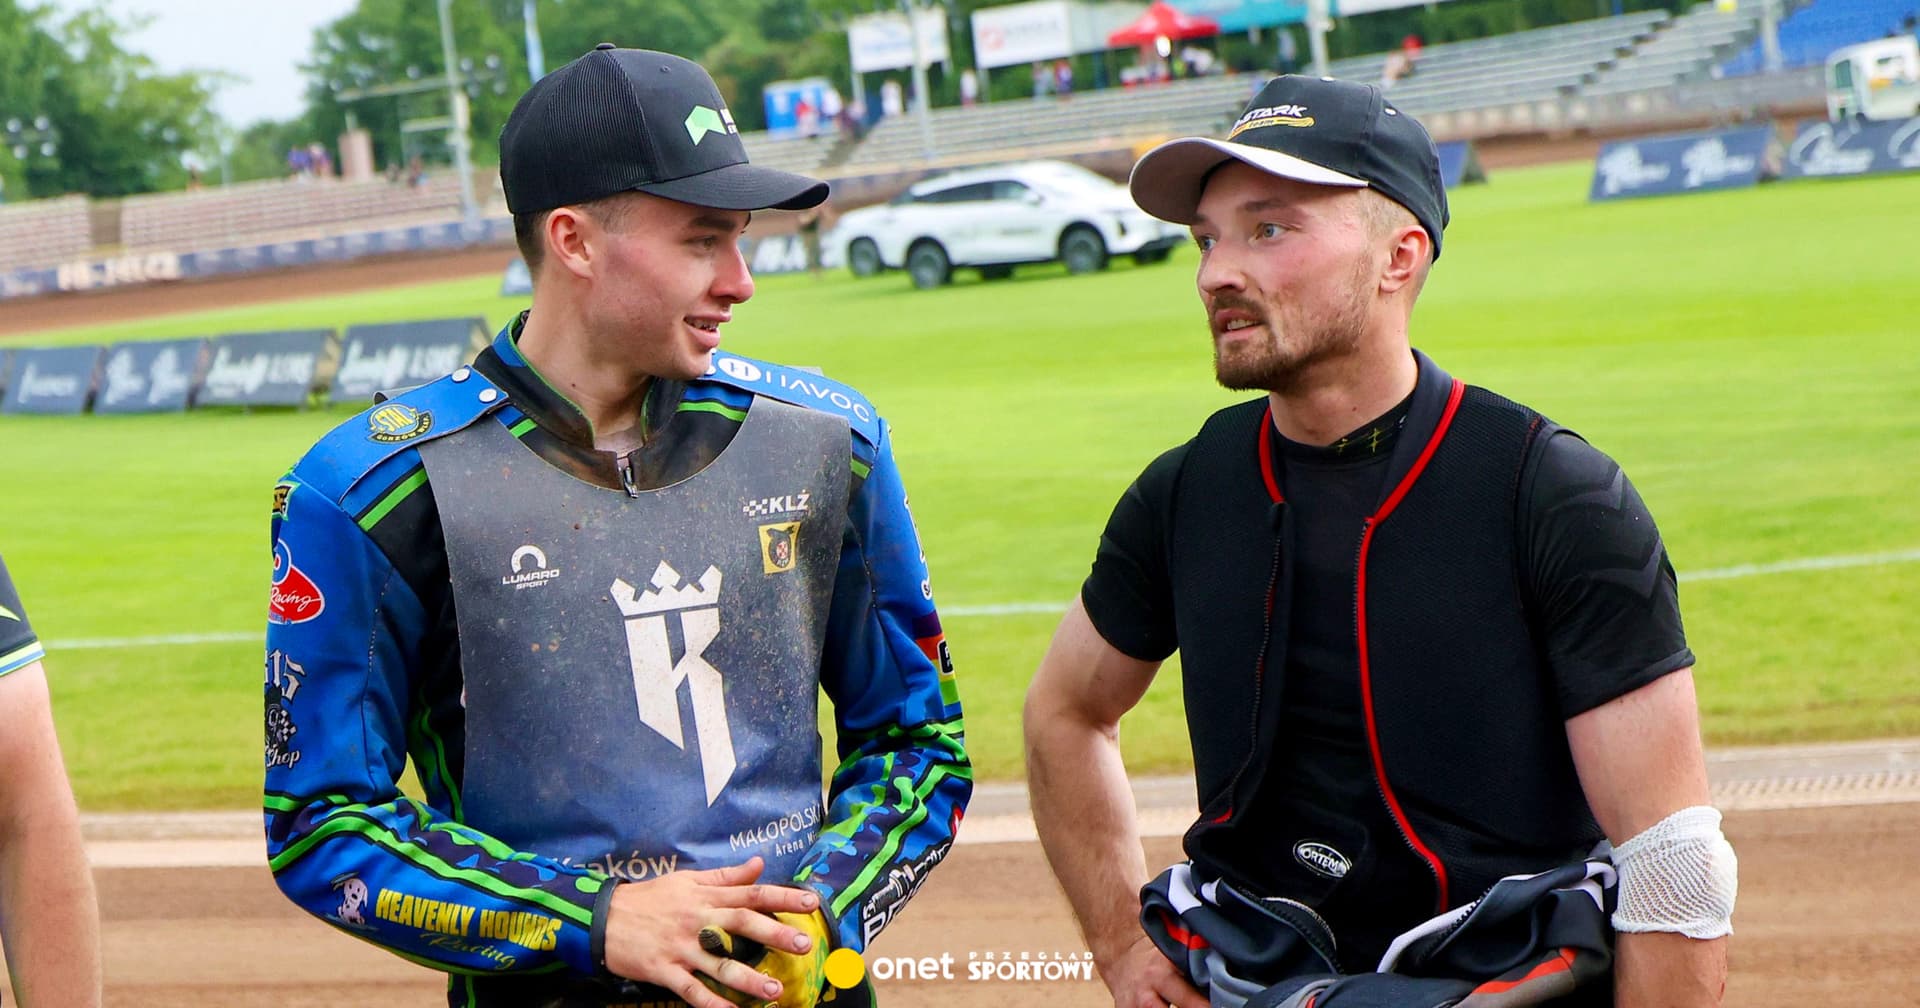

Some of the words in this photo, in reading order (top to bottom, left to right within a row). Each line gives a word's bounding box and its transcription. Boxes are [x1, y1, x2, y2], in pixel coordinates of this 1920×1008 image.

[502, 568, 560, 585] LUMARO
[516, 579, 549, 590] SPORT
[775, 838, 804, 857] Arena
[375, 887, 477, 938] HEAVENLY
[479, 907, 564, 952] HOUNDS
[420, 930, 516, 971] Racing
